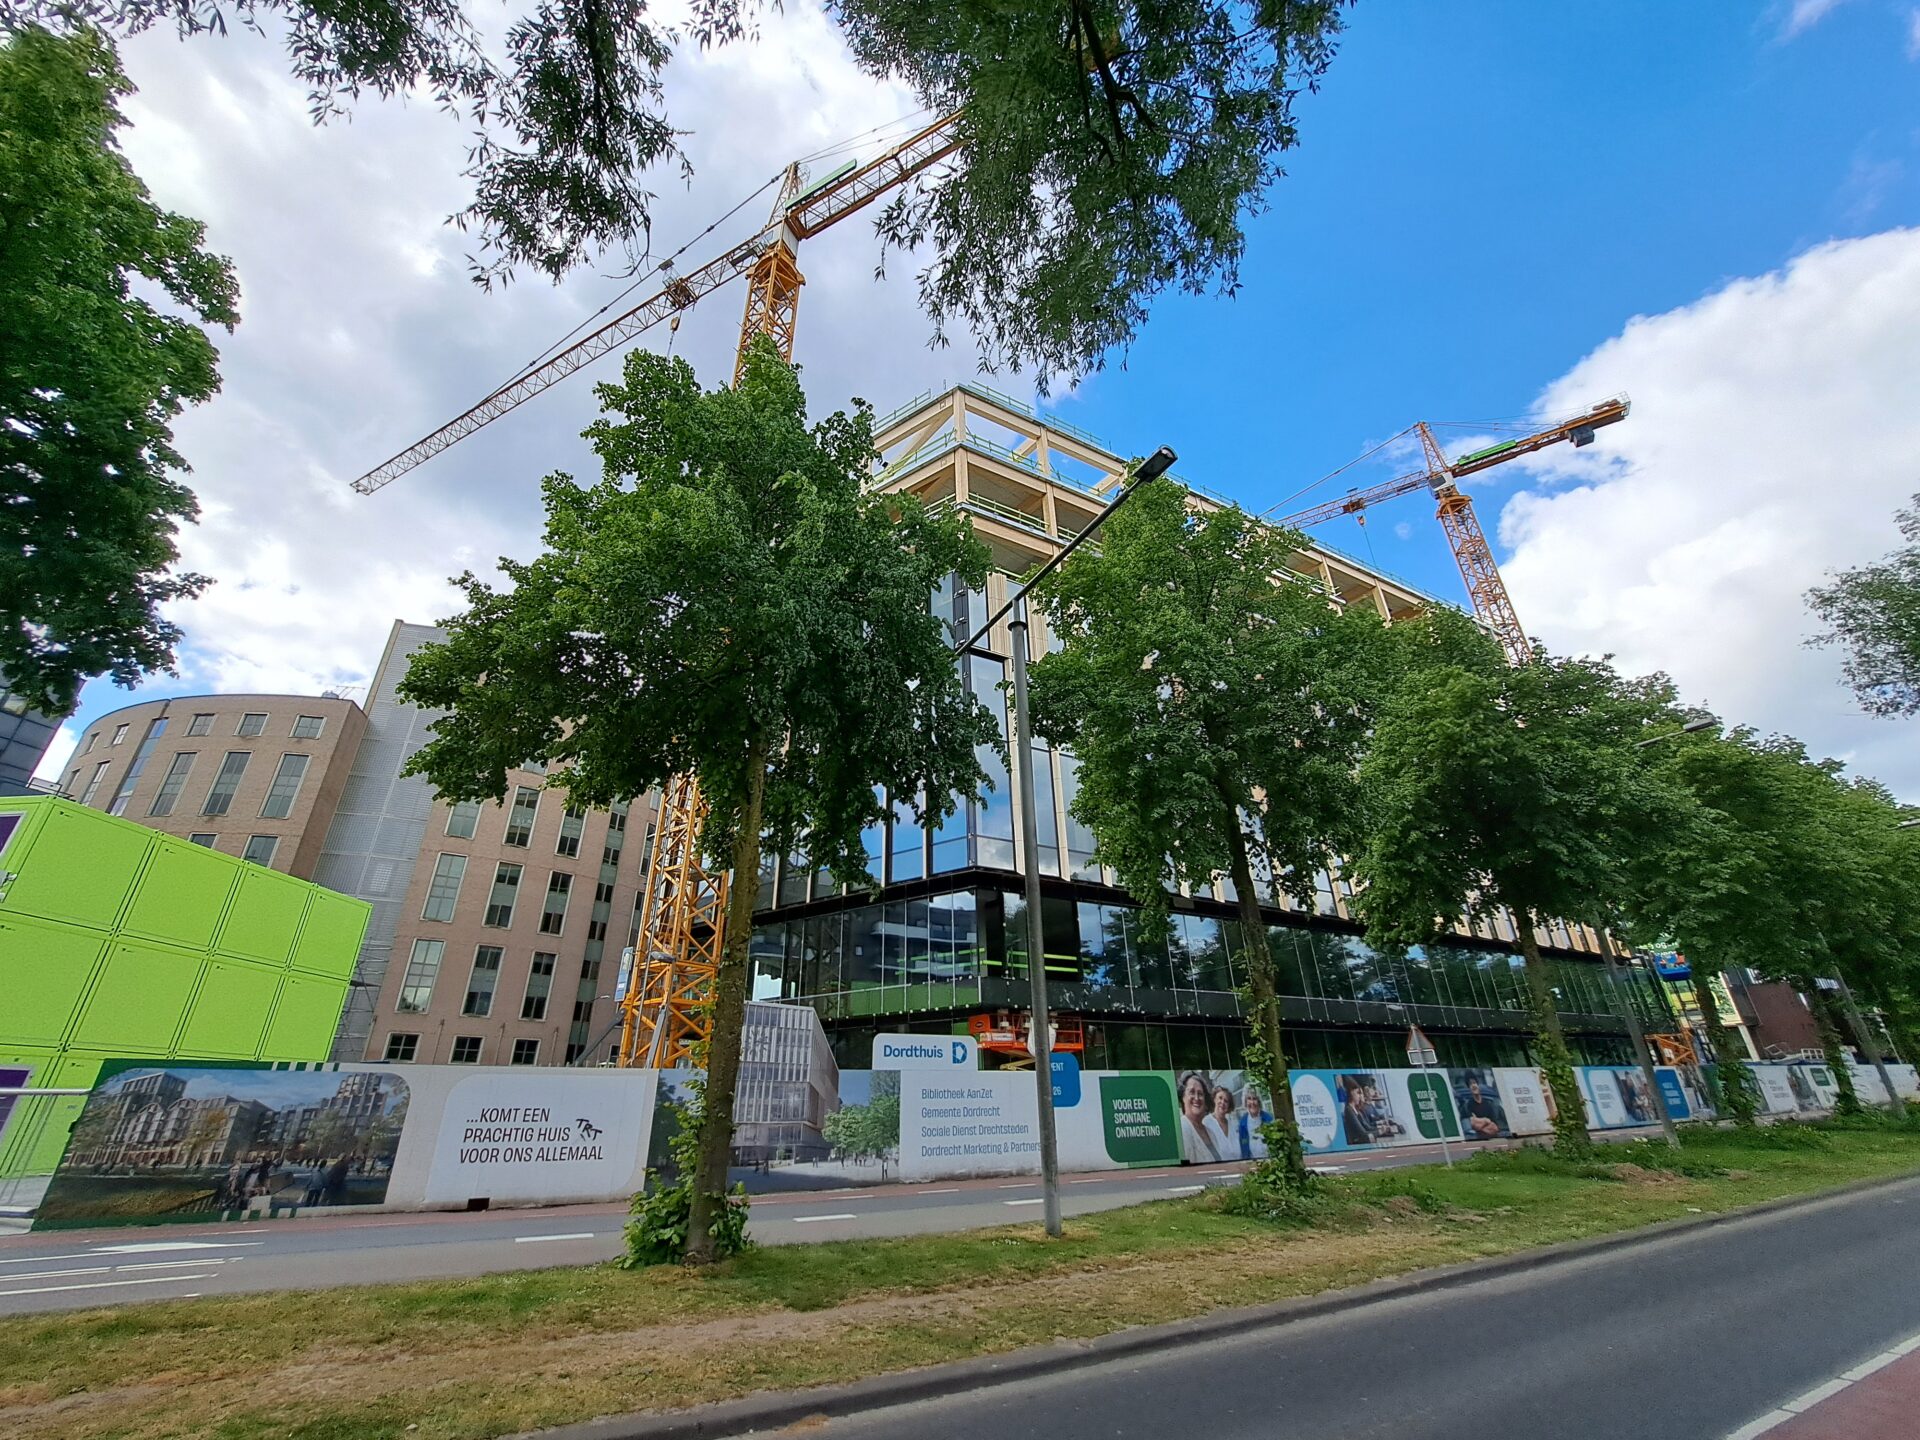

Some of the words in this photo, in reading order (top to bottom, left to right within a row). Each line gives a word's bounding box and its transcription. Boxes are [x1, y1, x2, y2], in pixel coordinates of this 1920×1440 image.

[883, 1044, 944, 1058] Dordthuis
[921, 1088, 965, 1099] Bibliotheek
[967, 1088, 993, 1099] AanZet
[1112, 1098, 1133, 1110] VOOR
[1133, 1098, 1148, 1110] EEN
[522, 1107, 551, 1122] EEN
[921, 1107, 961, 1118] Gemeente
[963, 1106, 1000, 1117] Dordrecht
[1114, 1112, 1151, 1124] SPONTANE
[463, 1127, 534, 1143] PRACHTIG
[537, 1127, 571, 1142] HUIS
[921, 1126, 951, 1137] Sociale
[952, 1125, 977, 1136] Dienst
[978, 1124, 1029, 1135] Drechtsteden
[1115, 1125, 1161, 1138] ONTMOETING
[460, 1148, 499, 1164] VOOR
[503, 1147, 532, 1162] ONS
[535, 1146, 604, 1162] ALLEMAAL
[921, 1145, 961, 1157] Dordrecht
[963, 1143, 1003, 1155] Marketing
[1003, 1143, 1010, 1153] &
